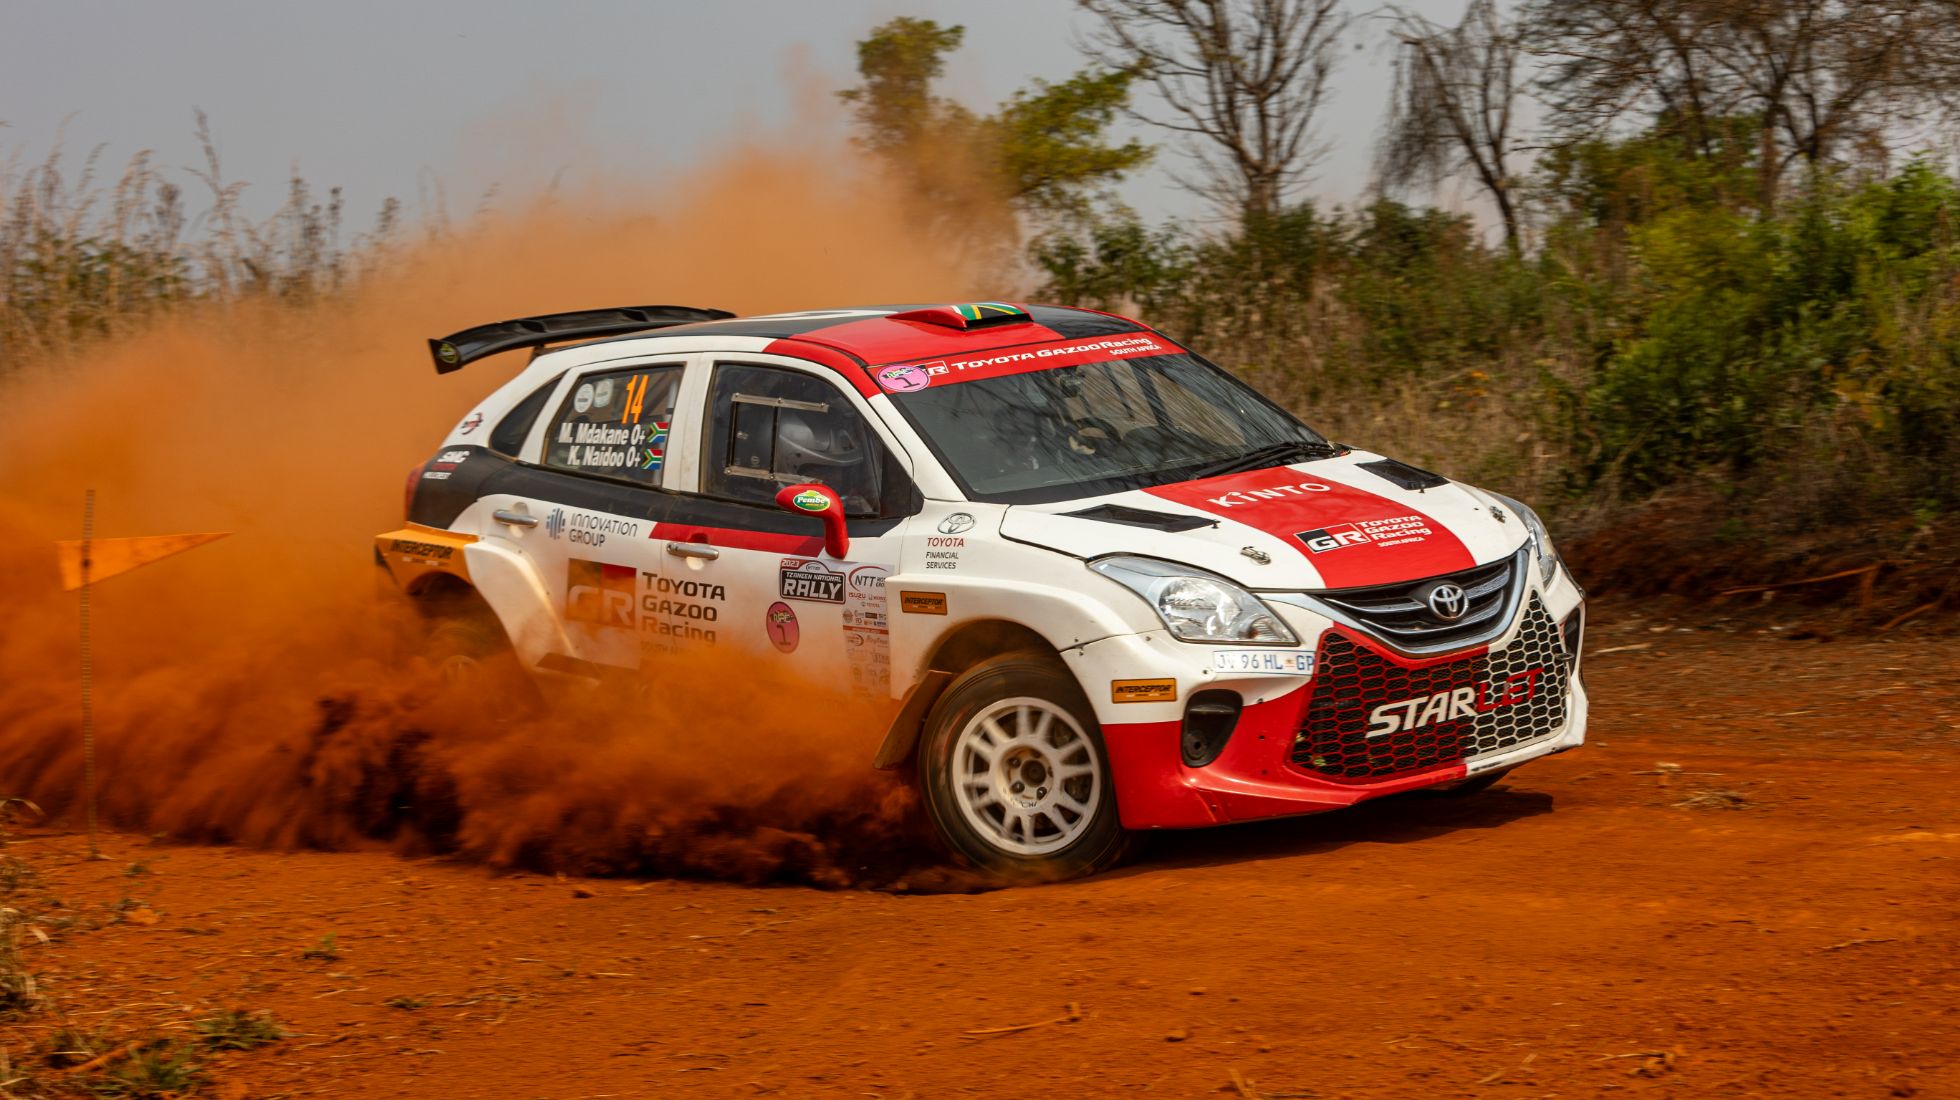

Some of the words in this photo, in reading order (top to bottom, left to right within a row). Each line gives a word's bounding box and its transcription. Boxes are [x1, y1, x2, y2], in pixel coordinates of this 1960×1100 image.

[951, 353, 1035, 370] TOYOTA
[1036, 343, 1100, 358] GAZOO
[1099, 338, 1152, 349] Racing
[1109, 347, 1137, 356] SOUTH
[1139, 343, 1162, 353] AFRICA
[895, 377, 920, 388] 1
[622, 374, 649, 424] 14
[558, 422, 573, 443] M.
[575, 424, 629, 445] Mdakane
[567, 445, 580, 465] K.
[582, 446, 625, 467] Naidoo
[1355, 515, 1422, 527] TOYOTA
[1364, 521, 1424, 534] GAZOO
[569, 529, 605, 547] GROUP
[1307, 530, 1367, 552] GR
[1370, 528, 1432, 541] Racing
[927, 537, 964, 547] TOYOTA
[1377, 539, 1400, 547] SOUTH
[1401, 536, 1425, 544] AFRICA
[390, 539, 454, 559] INTERCEPTOR
[926, 552, 959, 560] FINANCIAL
[781, 560, 800, 568] 2023
[926, 561, 956, 569] SERVICES
[786, 571, 812, 580] TZANEEN
[813, 574, 842, 582] NATIONAL
[855, 575, 876, 587] NTT
[642, 571, 726, 601] TOYOTA
[783, 578, 842, 600] RALLY
[848, 592, 866, 600] ISUZU
[903, 597, 943, 605] INTERCEPTOR
[642, 594, 718, 622] GAZOO
[641, 614, 717, 647] Racing
[776, 624, 791, 646] 1
[1241, 654, 1260, 669] 96
[1263, 654, 1284, 670] HL
[1296, 655, 1316, 670] GP
[1115, 685, 1171, 693] INTERCEPTOR
[1365, 667, 1545, 739] STARLET
